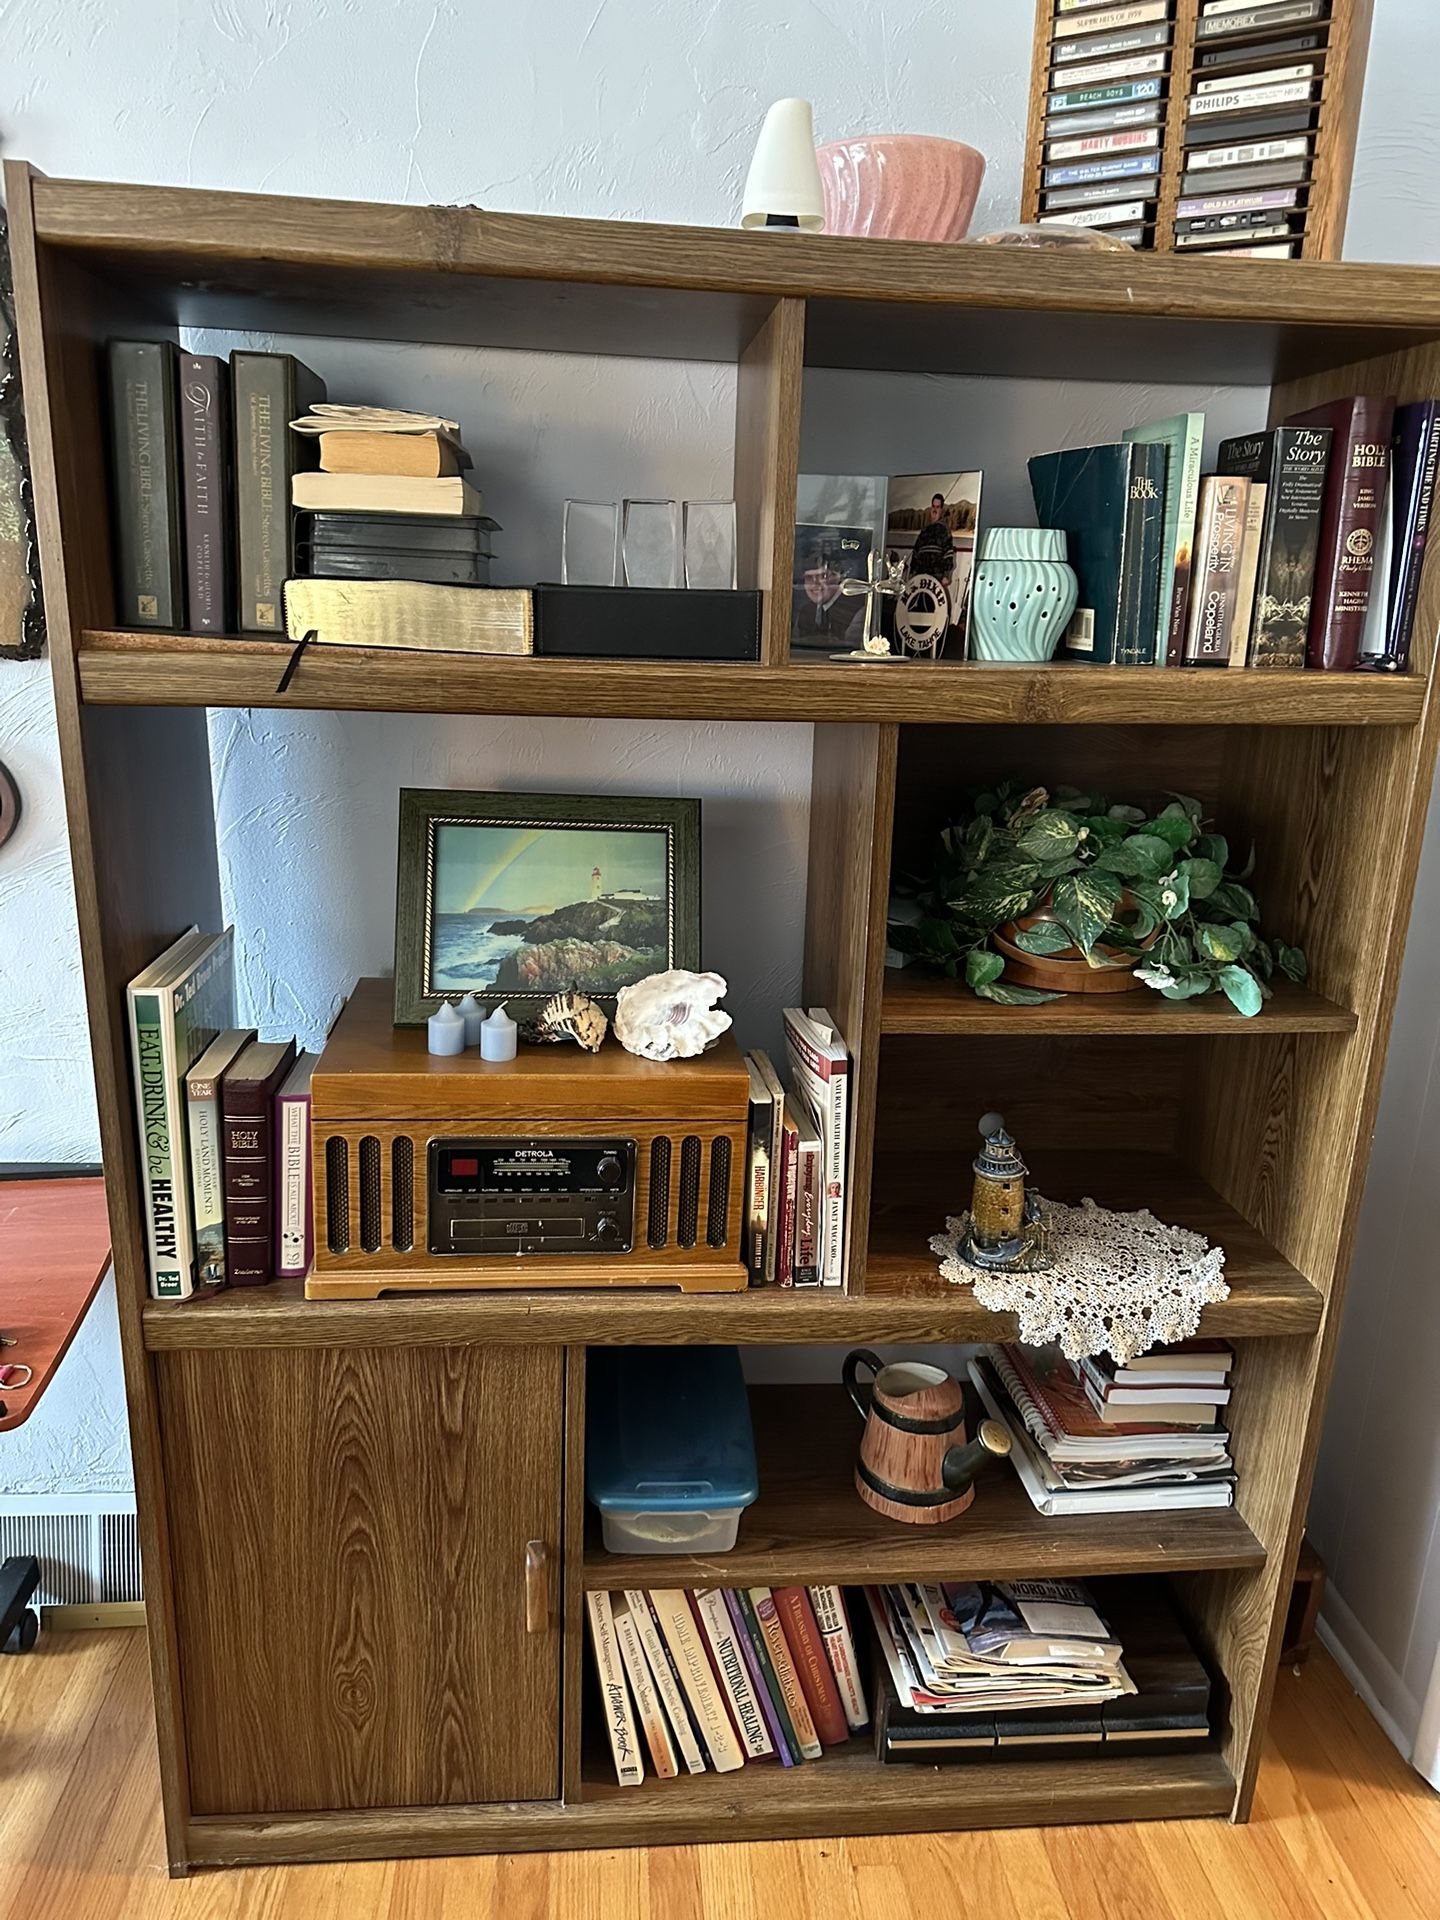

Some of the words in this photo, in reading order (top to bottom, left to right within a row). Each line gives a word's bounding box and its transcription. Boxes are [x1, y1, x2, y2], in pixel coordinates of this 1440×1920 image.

[1207, 15, 1256, 32] MEMOREX
[1080, 92, 1102, 102] BEACH
[1106, 88, 1123, 98] BOYS
[1136, 82, 1155, 95] 120
[1195, 94, 1240, 110] PHILIPS
[1080, 137, 1110, 152] MARTY
[1203, 200, 1221, 210] GOLD
[136, 380, 148, 412] THE
[259, 394, 271, 425] THE
[136, 413, 151, 463] LIVING
[259, 425, 272, 475] LIVING
[1191, 436, 1200, 445] A
[1227, 442, 1243, 460] The
[1242, 440, 1265, 460] Story
[1295, 430, 1323, 446] The
[1353, 444, 1387, 456] HOLY
[1427, 417, 1440, 466] CHARTING
[1286, 446, 1326, 465] Story
[1351, 456, 1386, 468] BIBLE
[140, 464, 153, 501] BIBLE
[1134, 476, 1155, 489] THE
[1184, 447, 1200, 500] Miraculous
[1423, 466, 1435, 486] THE
[196, 463, 208, 514] FAITH
[260, 476, 273, 513] BIBLE
[1130, 485, 1159, 499] BOOK
[1421, 486, 1432, 505] END
[140, 503, 152, 538] Stereo
[1183, 500, 1194, 518] Life
[1417, 505, 1429, 532] TIMES
[262, 514, 272, 548] Stereo
[1207, 512, 1225, 574] Prosperity
[1219, 508, 1238, 554] LIVING
[143, 540, 153, 589] Cassettes
[196, 545, 204, 600] COPELAND
[263, 549, 273, 597] Cassettes
[1218, 557, 1232, 573] IN
[1341, 555, 1374, 565] RHEMA
[919, 577, 946, 607] DIXIE
[1217, 592, 1227, 622] KENNETH
[1202, 590, 1220, 653] Copeland
[899, 625, 916, 648] LAKE
[917, 627, 943, 650] TAHOE
[1119, 647, 1147, 655] TYNDALE
[1213, 628, 1222, 653] GLORIA
[174, 993, 185, 1013] Dr.
[139, 1028, 162, 1067] EAT,
[142, 1069, 167, 1130] DRINK
[190, 1082, 212, 1091] ONE
[191, 1089, 213, 1097] YEAR
[833, 1078, 843, 1112] NATURAL
[199, 1109, 209, 1137] HOLY
[290, 1106, 299, 1129] WHAT
[833, 1112, 842, 1140] HEALTH
[146, 1131, 171, 1154] &
[231, 1131, 259, 1140] HOLY
[232, 1140, 259, 1149] BIBLE
[290, 1130, 299, 1145] THE
[149, 1155, 171, 1174] be
[200, 1139, 211, 1167] LAND
[287, 1146, 301, 1180] BIBLE
[515, 1150, 554, 1158] DETROLA
[832, 1141, 841, 1180] REMEDIES
[290, 1181, 297, 1189] IS
[803, 1151, 815, 1193] Enjoying
[203, 1168, 214, 1215] MOMENTS
[753, 1166, 767, 1211] HARBINGER
[151, 1178, 177, 1259] HEALTHY
[289, 1203, 297, 1226] ABOUT
[801, 1191, 815, 1236] Everyday
[831, 1200, 839, 1222] JANET
[799, 1239, 814, 1266] Life
[830, 1223, 839, 1260] MACCARO
[790, 1595, 799, 1604] A
[1008, 1583, 1047, 1595] WORD
[1055, 1586, 1079, 1599] LIFE
[791, 1603, 811, 1644] TREASURY
[599, 1622, 615, 1681] Self-Management
[623, 1628, 638, 1657] BREAKING
[804, 1644, 813, 1656] OF
[829, 1635, 838, 1651] HEART
[632, 1656, 641, 1667] THE
[766, 1618, 787, 1664] Reverse
[779, 1662, 798, 1708] diabetes
[635, 1668, 645, 1690] FOOD
[644, 1628, 655, 1650] Giant
[651, 1649, 663, 1669] Book
[662, 1677, 677, 1707] Diabetic
[672, 1706, 688, 1737] Cooking
[671, 1611, 692, 1646] HOME
[683, 1646, 718, 1722] IMPROVEMENT
[710, 1725, 728, 1753] 1-2-3
[716, 1635, 750, 1704] NUTRITIONAL
[738, 1699, 764, 1744] HEALING
[808, 1655, 827, 1706] CHRISTMAS
[640, 1685, 653, 1715] Seduction
